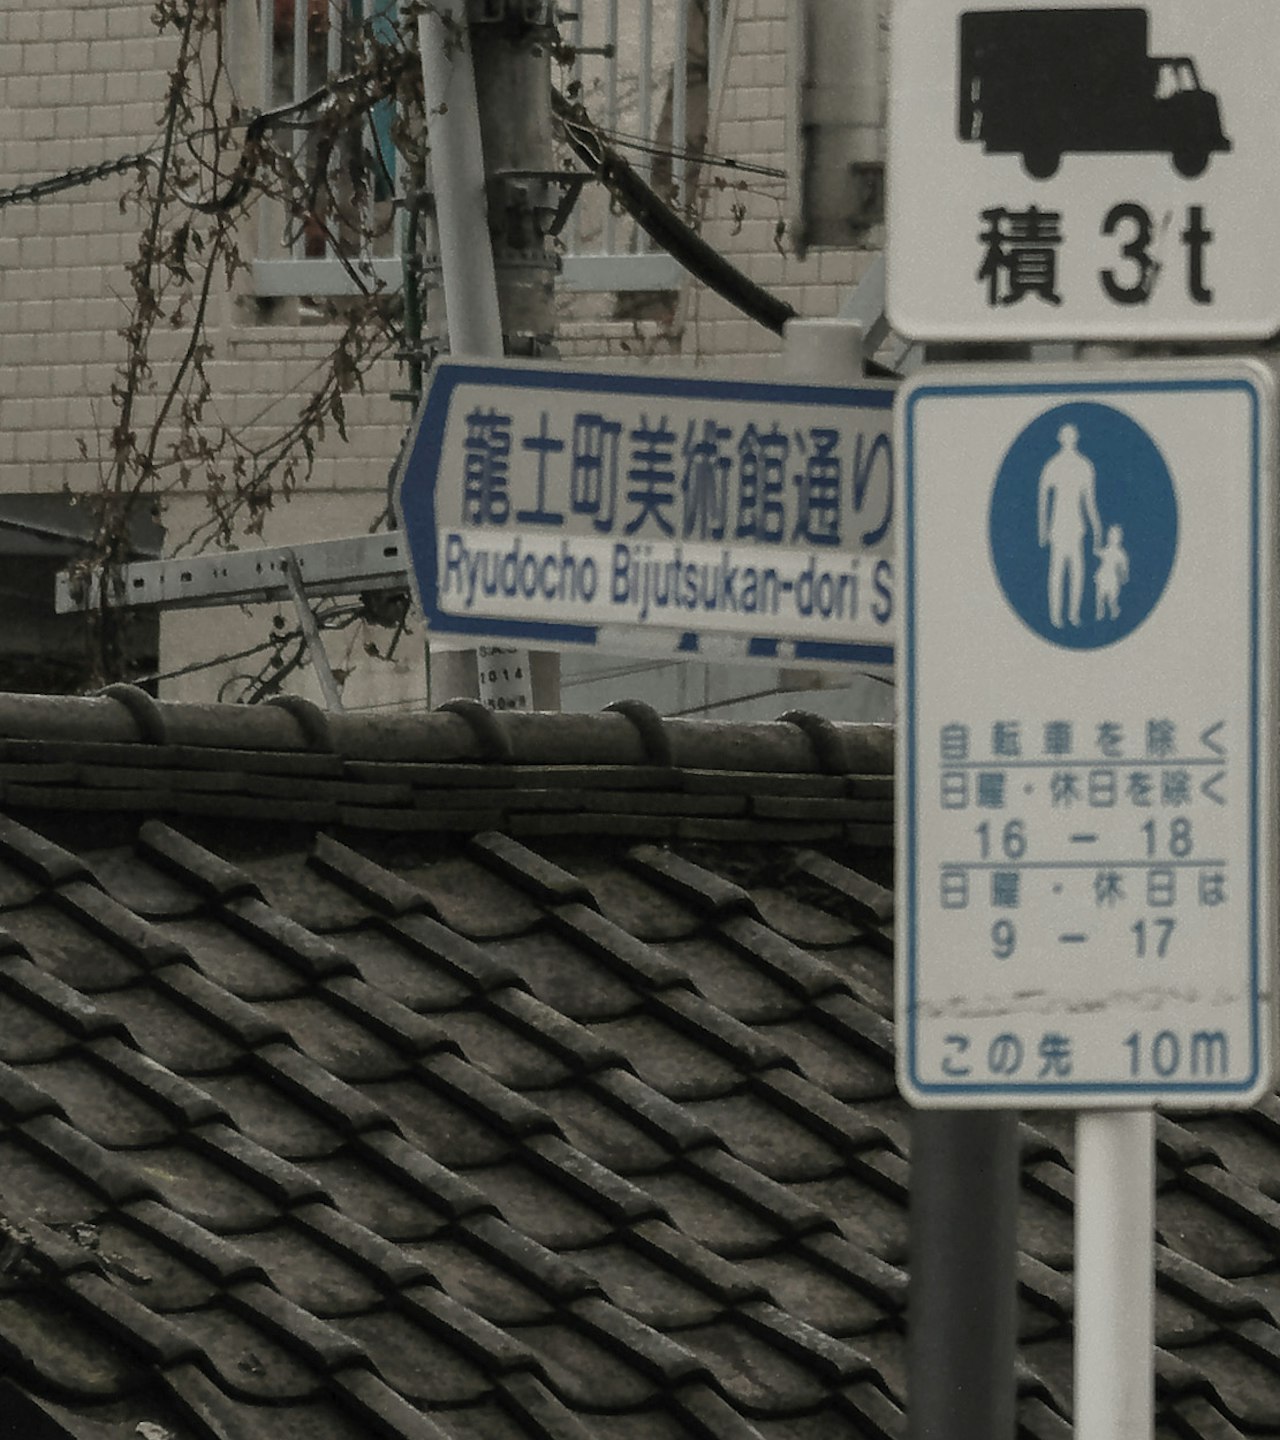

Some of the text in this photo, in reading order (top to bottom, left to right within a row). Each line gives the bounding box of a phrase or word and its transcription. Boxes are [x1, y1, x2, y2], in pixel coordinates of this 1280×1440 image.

[462, 407, 893, 546] 龍土町美術館通り
[443, 533, 598, 608] Ryudocho
[611, 544, 860, 620] Bijutsukan-dori
[941, 719, 1226, 759] 自転車を除く
[975, 818, 1027, 859] 16
[1141, 817, 1194, 857] 18
[990, 919, 1016, 959] 9
[1131, 919, 1175, 958] 17
[941, 1030, 1229, 1078] この先 10m
